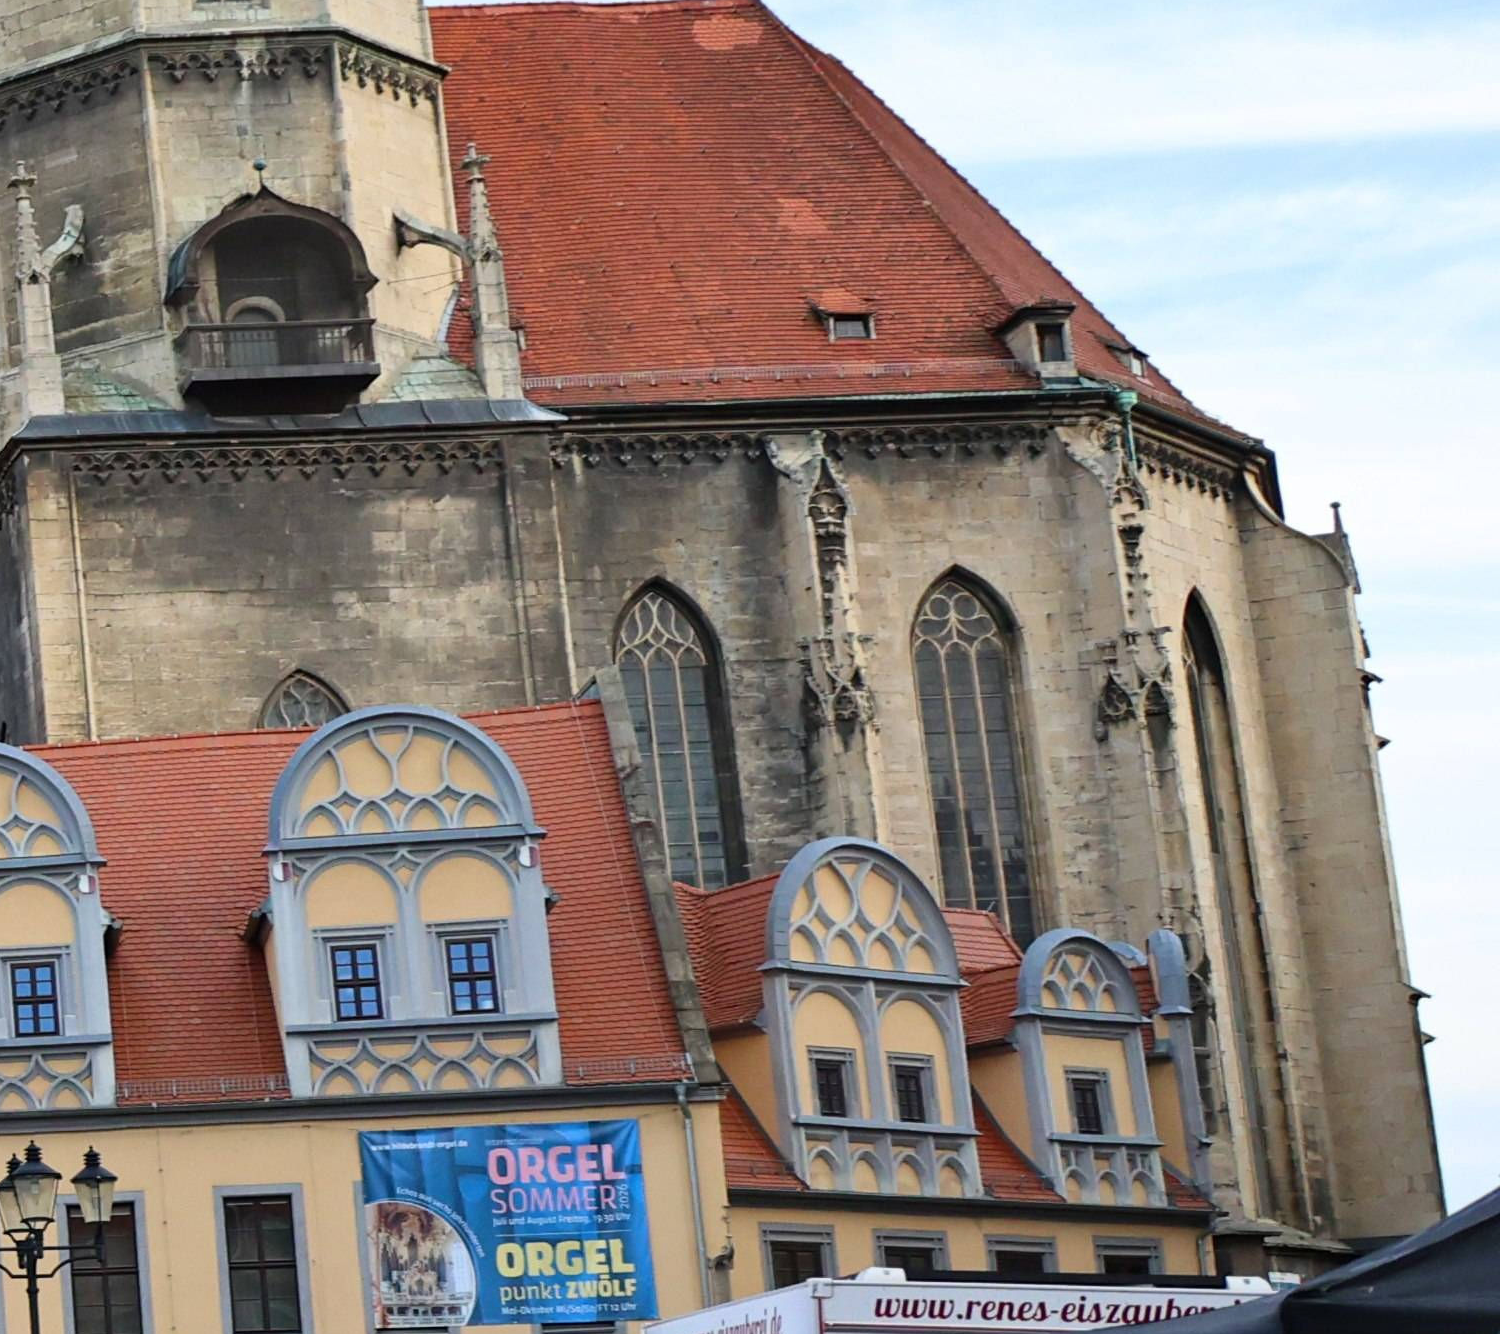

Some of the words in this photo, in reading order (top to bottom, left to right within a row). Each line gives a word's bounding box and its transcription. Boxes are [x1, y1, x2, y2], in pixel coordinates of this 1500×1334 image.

[487, 1143, 627, 1185] ORGEL
[489, 1184, 618, 1214] SOMMER
[617, 1183, 629, 1209] 2026
[496, 1238, 636, 1278] ORGEL
[500, 1281, 562, 1305] punkt
[566, 1274, 637, 1299] ZWÖLF
